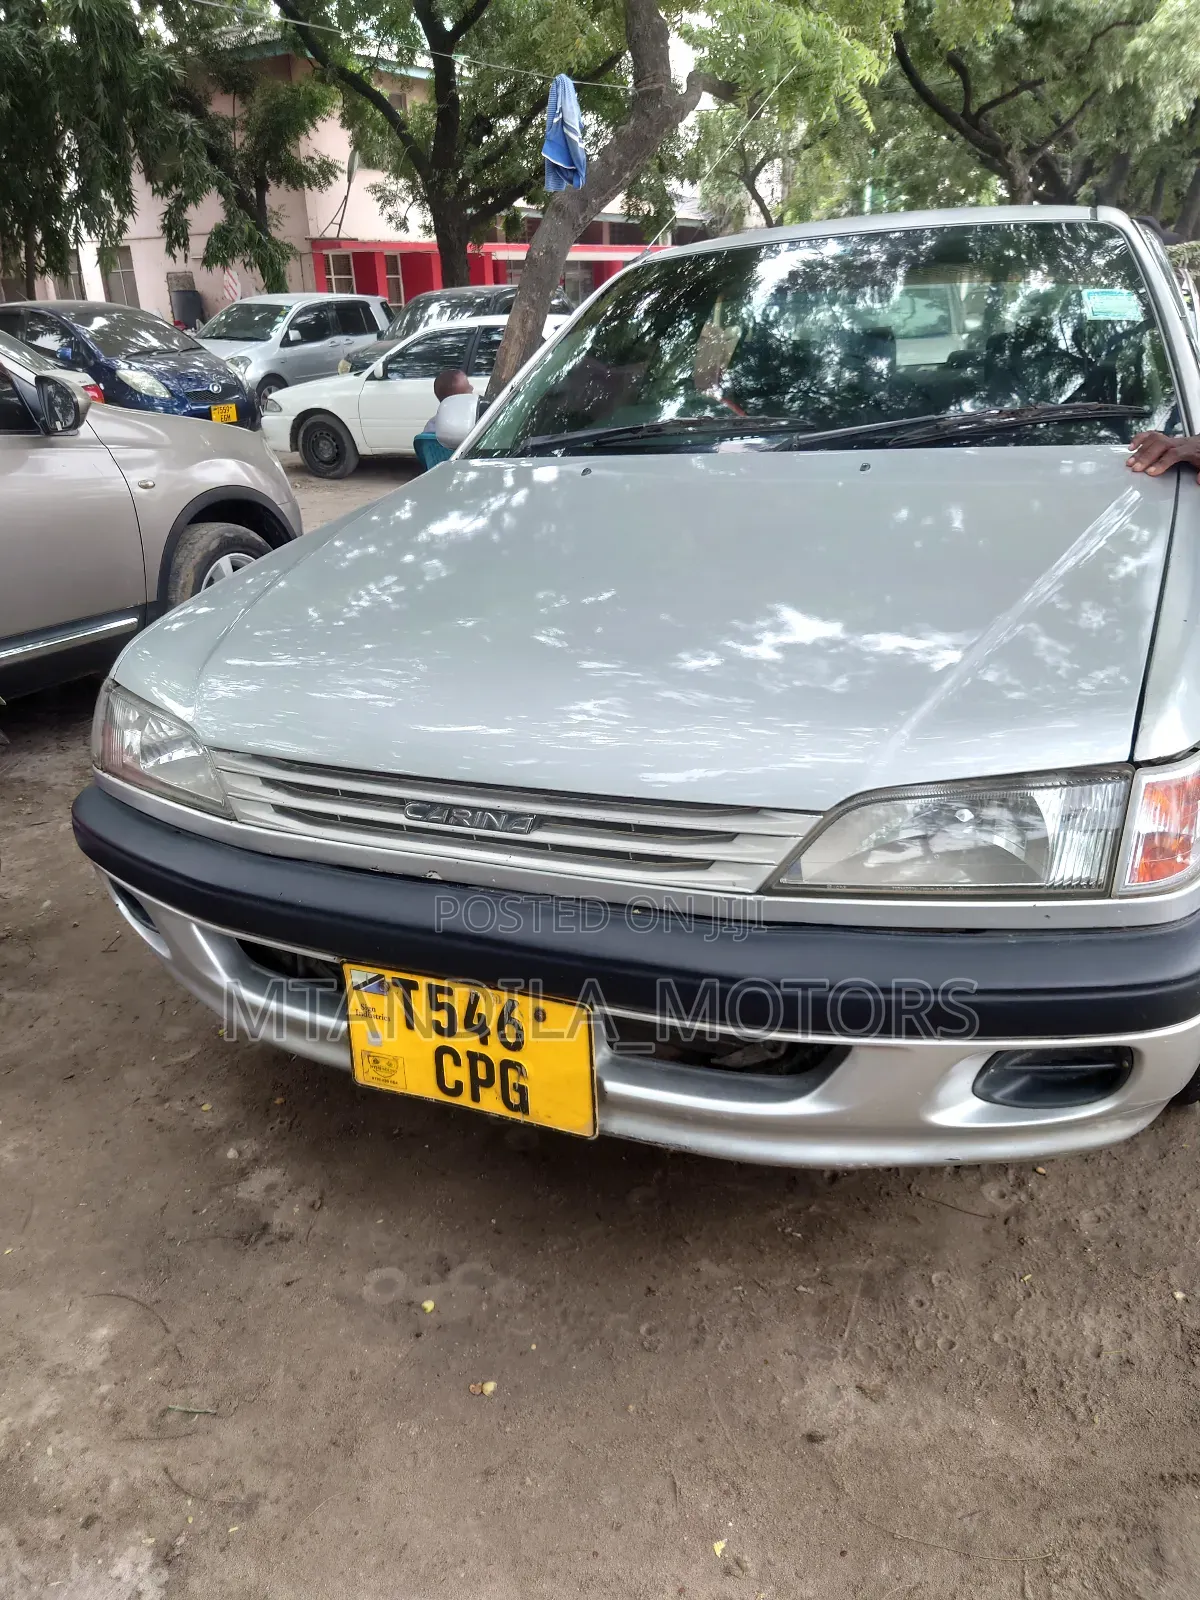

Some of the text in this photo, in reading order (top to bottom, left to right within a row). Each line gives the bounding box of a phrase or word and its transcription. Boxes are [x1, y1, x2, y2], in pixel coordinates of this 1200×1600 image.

[404, 801, 537, 834] CARINA
[391, 976, 525, 1051] T546
[434, 1045, 529, 1115] CPG
